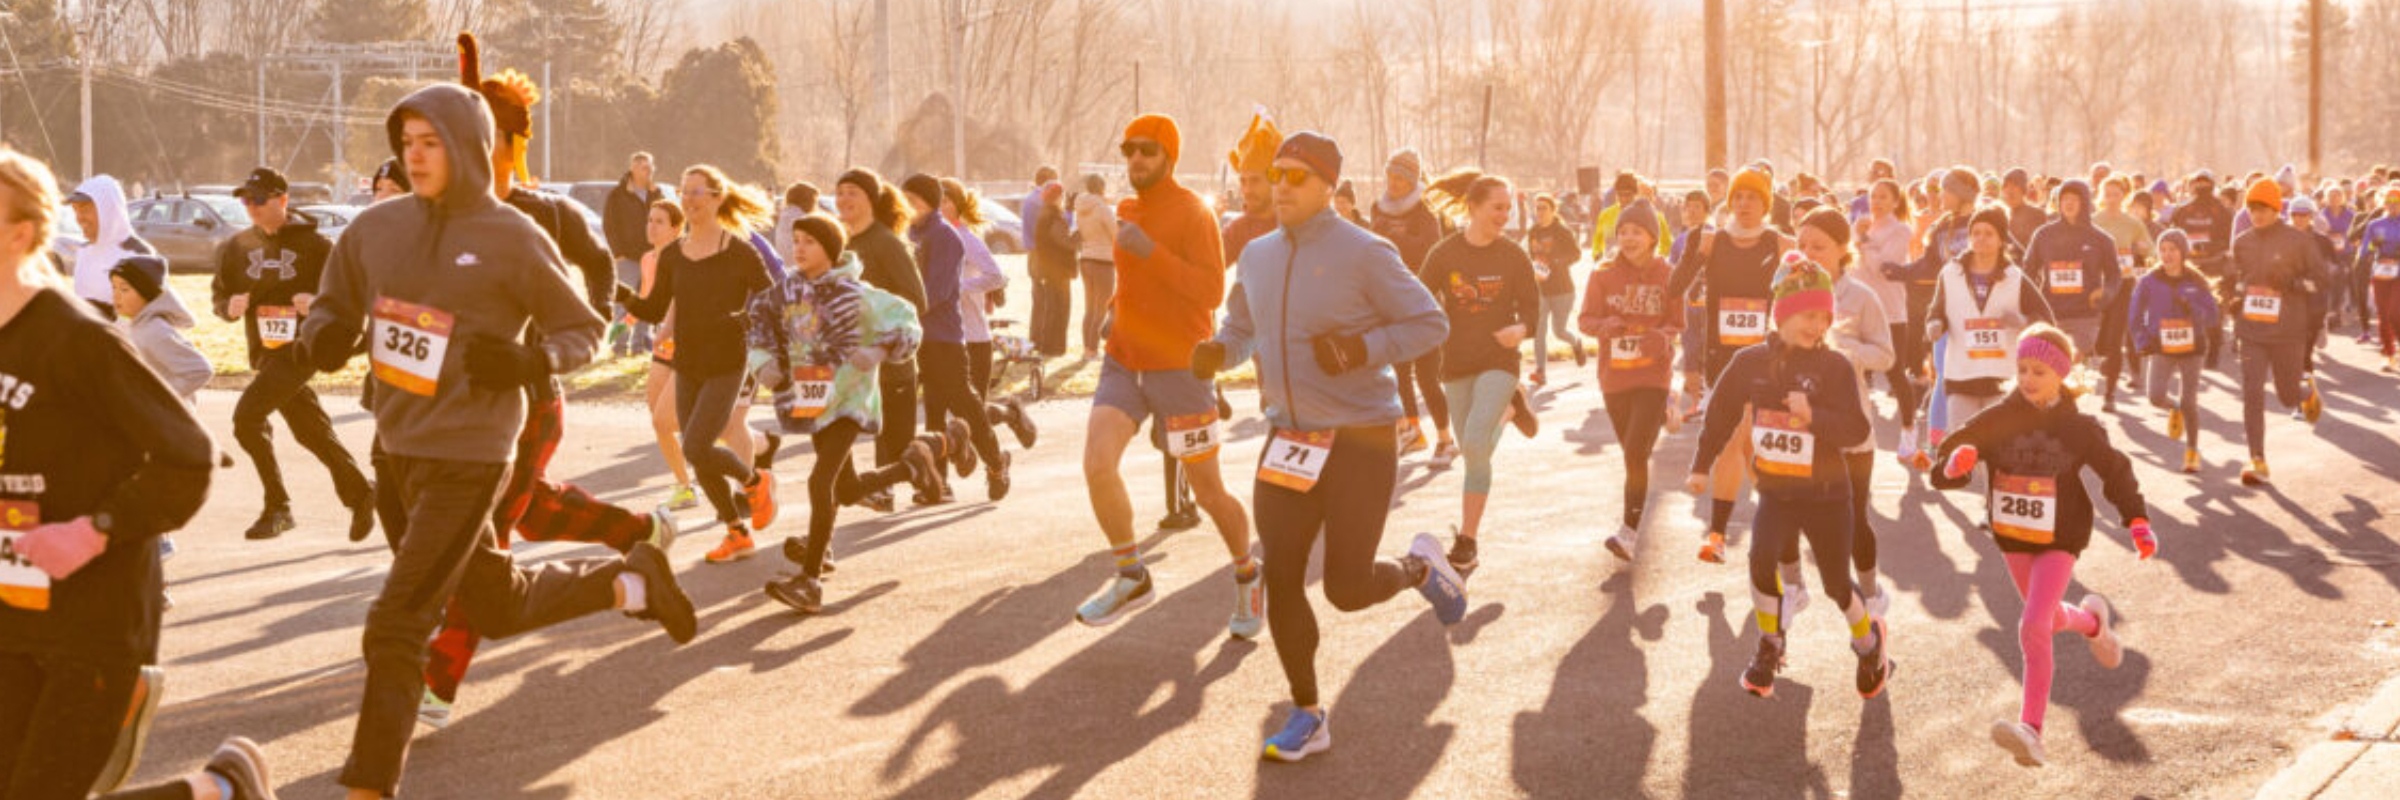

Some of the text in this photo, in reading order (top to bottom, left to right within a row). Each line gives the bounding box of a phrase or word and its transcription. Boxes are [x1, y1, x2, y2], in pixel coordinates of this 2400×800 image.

[266, 320, 288, 334] 172
[1726, 313, 1758, 328] 428
[384, 326, 431, 361] 326
[1974, 331, 1998, 343] 151
[0, 374, 34, 409] TS
[1185, 430, 1209, 447] 54
[1760, 432, 1803, 454] 449
[1284, 444, 1310, 465] 71
[2001, 495, 2045, 519] 288
